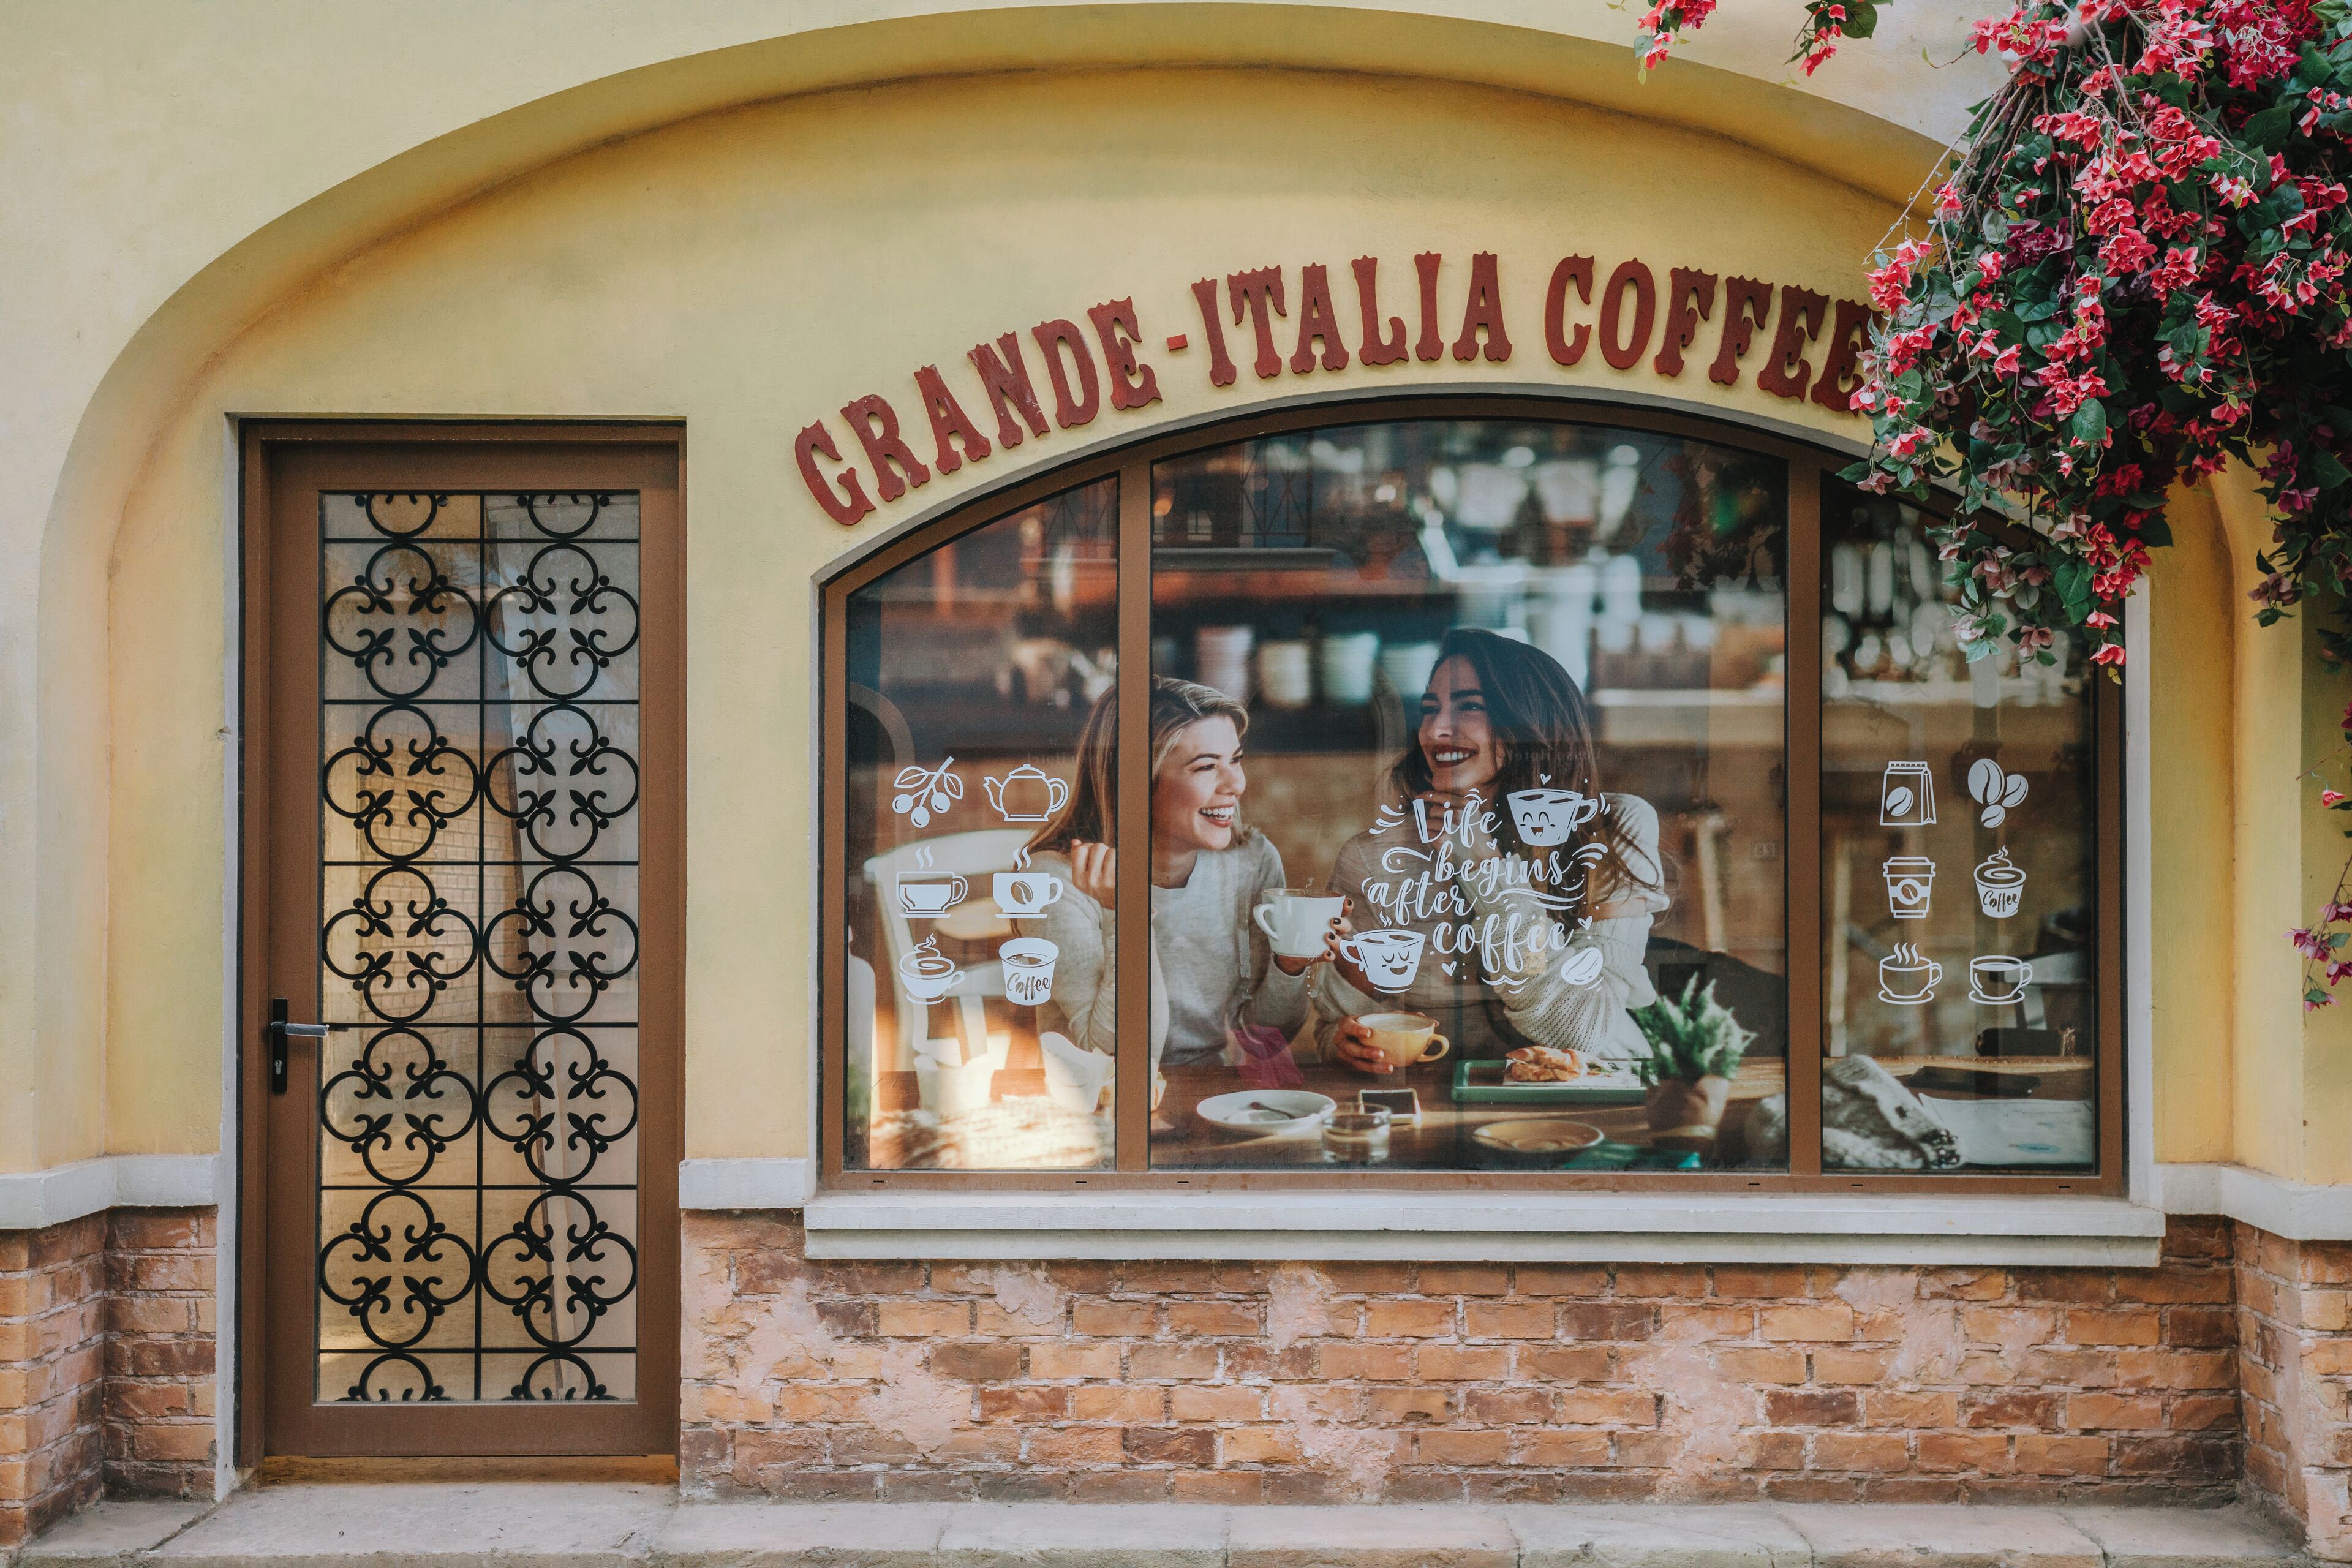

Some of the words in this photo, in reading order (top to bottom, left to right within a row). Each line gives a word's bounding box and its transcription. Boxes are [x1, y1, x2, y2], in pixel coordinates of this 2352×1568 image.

[794, 250, 1512, 526] GRANDE-ITALIA
[1545, 253, 1884, 418] COFFEE
[1412, 797, 1502, 848] Life
[1434, 840, 1574, 896] begins
[1366, 871, 1478, 926] after
[1983, 890, 2019, 913] Coffee
[1433, 912, 1574, 973] coffee
[1006, 972, 1051, 1000] Coffee
